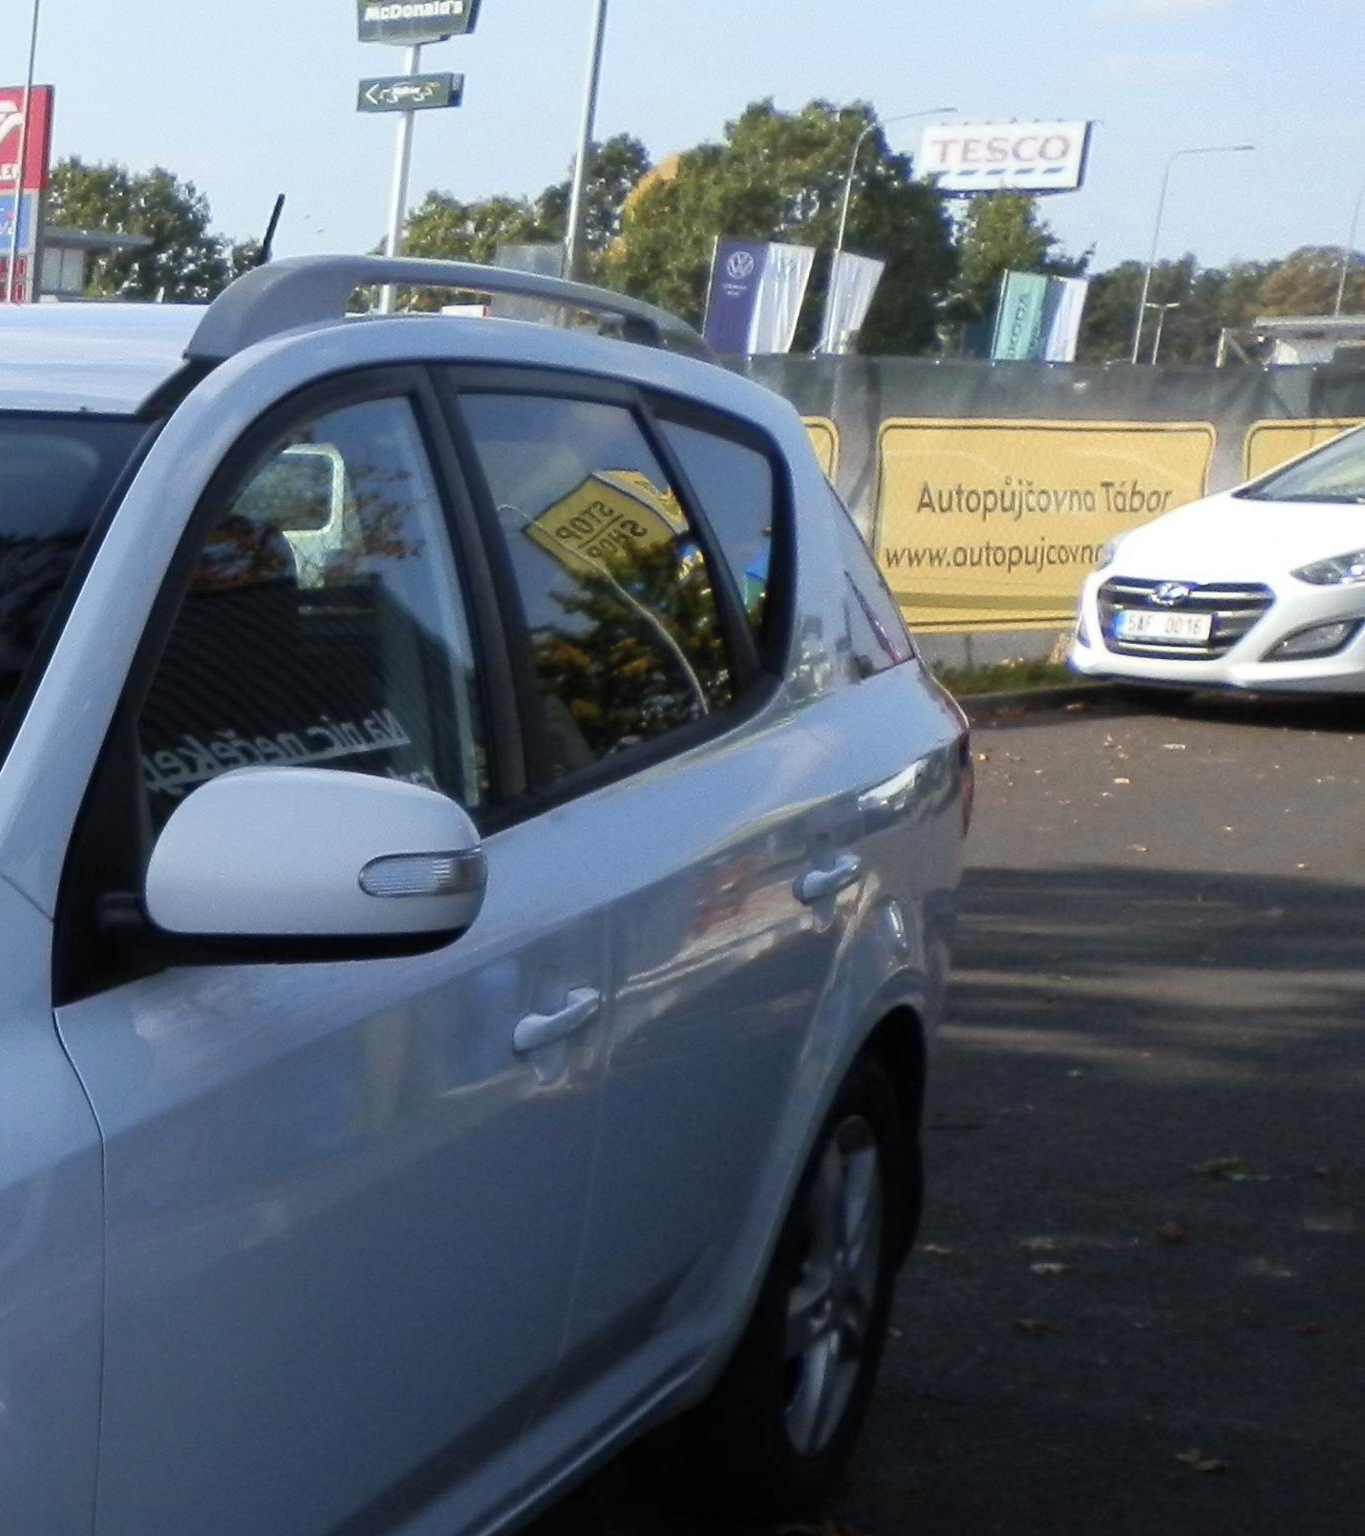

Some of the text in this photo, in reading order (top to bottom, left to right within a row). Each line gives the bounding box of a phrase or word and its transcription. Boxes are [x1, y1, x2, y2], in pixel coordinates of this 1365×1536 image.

[365, 0, 464, 20] McDonald's
[931, 136, 1070, 163] TESCO
[917, 476, 1172, 521] Autopůjčovna Tábor
